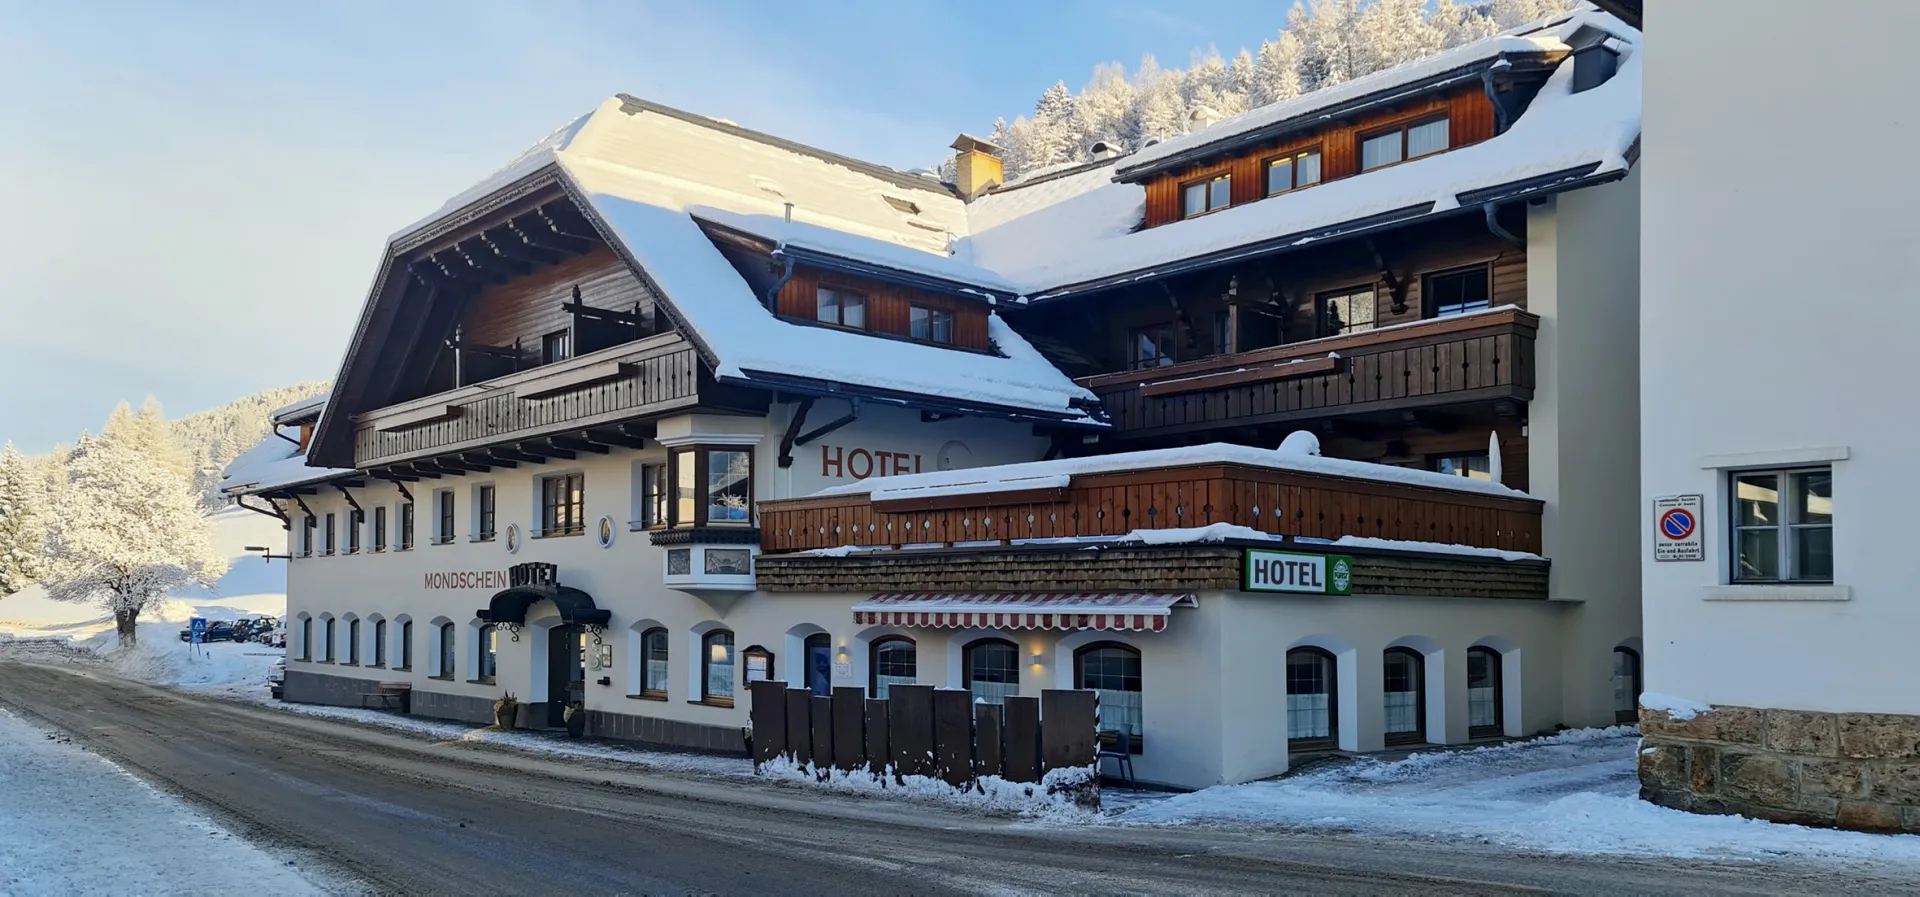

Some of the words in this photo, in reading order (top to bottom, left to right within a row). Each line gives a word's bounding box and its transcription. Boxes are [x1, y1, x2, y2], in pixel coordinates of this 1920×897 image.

[424, 570, 507, 589] MONDSCHEIN
[508, 561, 558, 588] HOTEL
[1254, 558, 1322, 588] HOTEL
